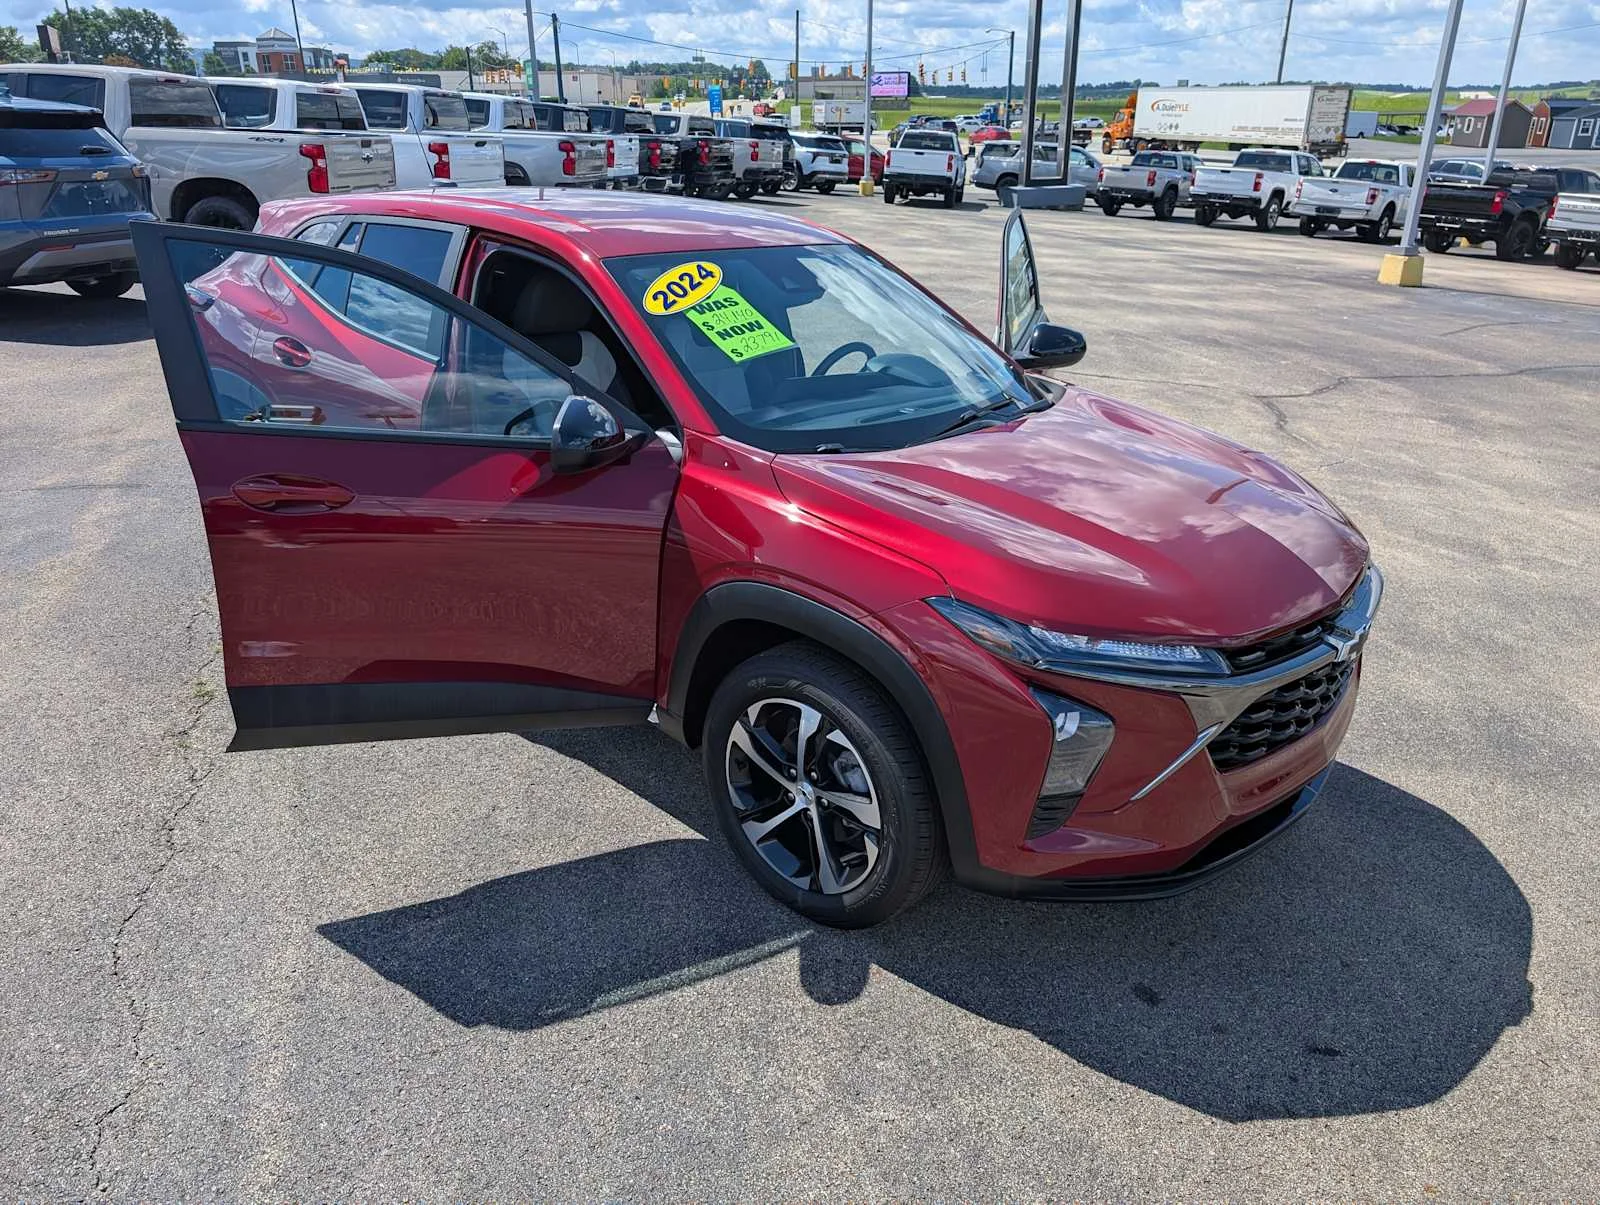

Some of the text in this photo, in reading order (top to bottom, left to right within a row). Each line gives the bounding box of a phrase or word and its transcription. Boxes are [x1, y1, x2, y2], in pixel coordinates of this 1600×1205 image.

[653, 264, 716, 310] 2024
[691, 297, 739, 315] WAS
[716, 320, 765, 341] NOW
